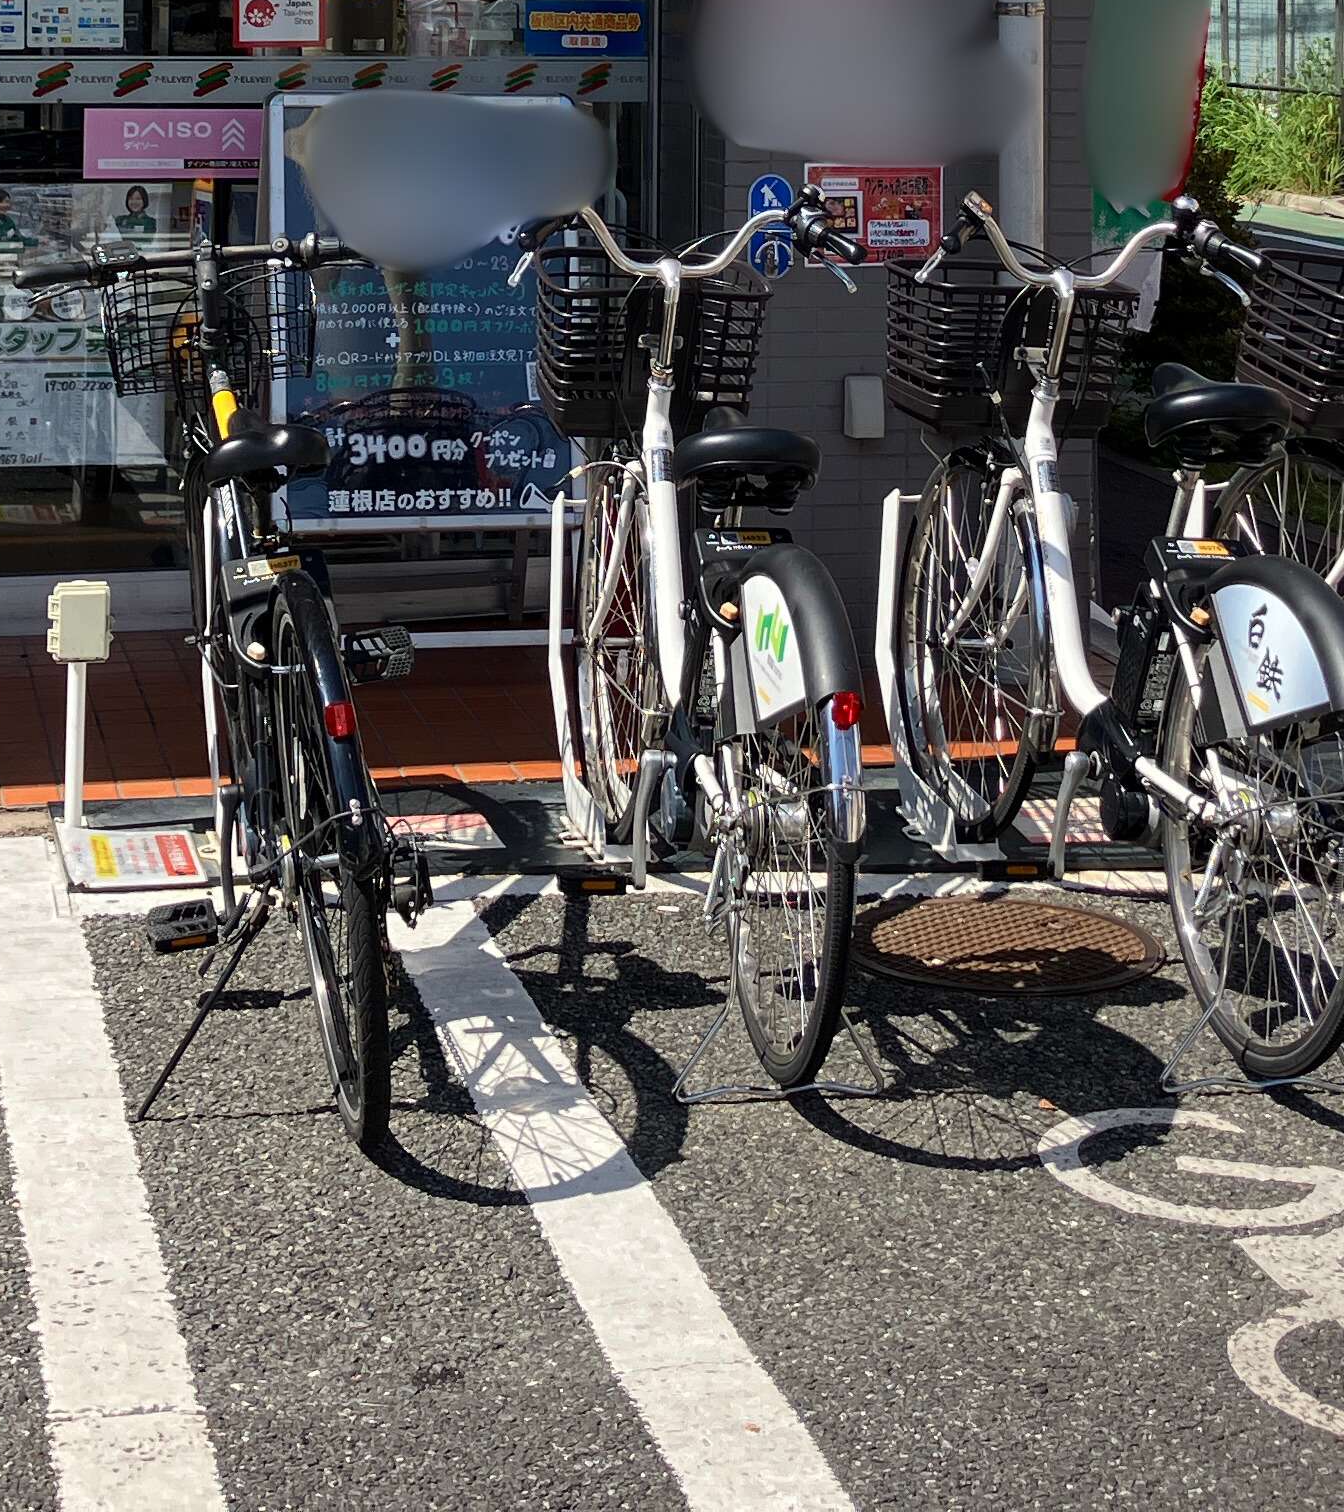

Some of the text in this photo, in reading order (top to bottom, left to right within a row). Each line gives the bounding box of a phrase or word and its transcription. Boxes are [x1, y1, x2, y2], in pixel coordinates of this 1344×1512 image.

[285, 0, 313, 10] Japan.
[123, 121, 212, 139] DAISO
[327, 488, 512, 513] 蓮根店のおすすめ!!
